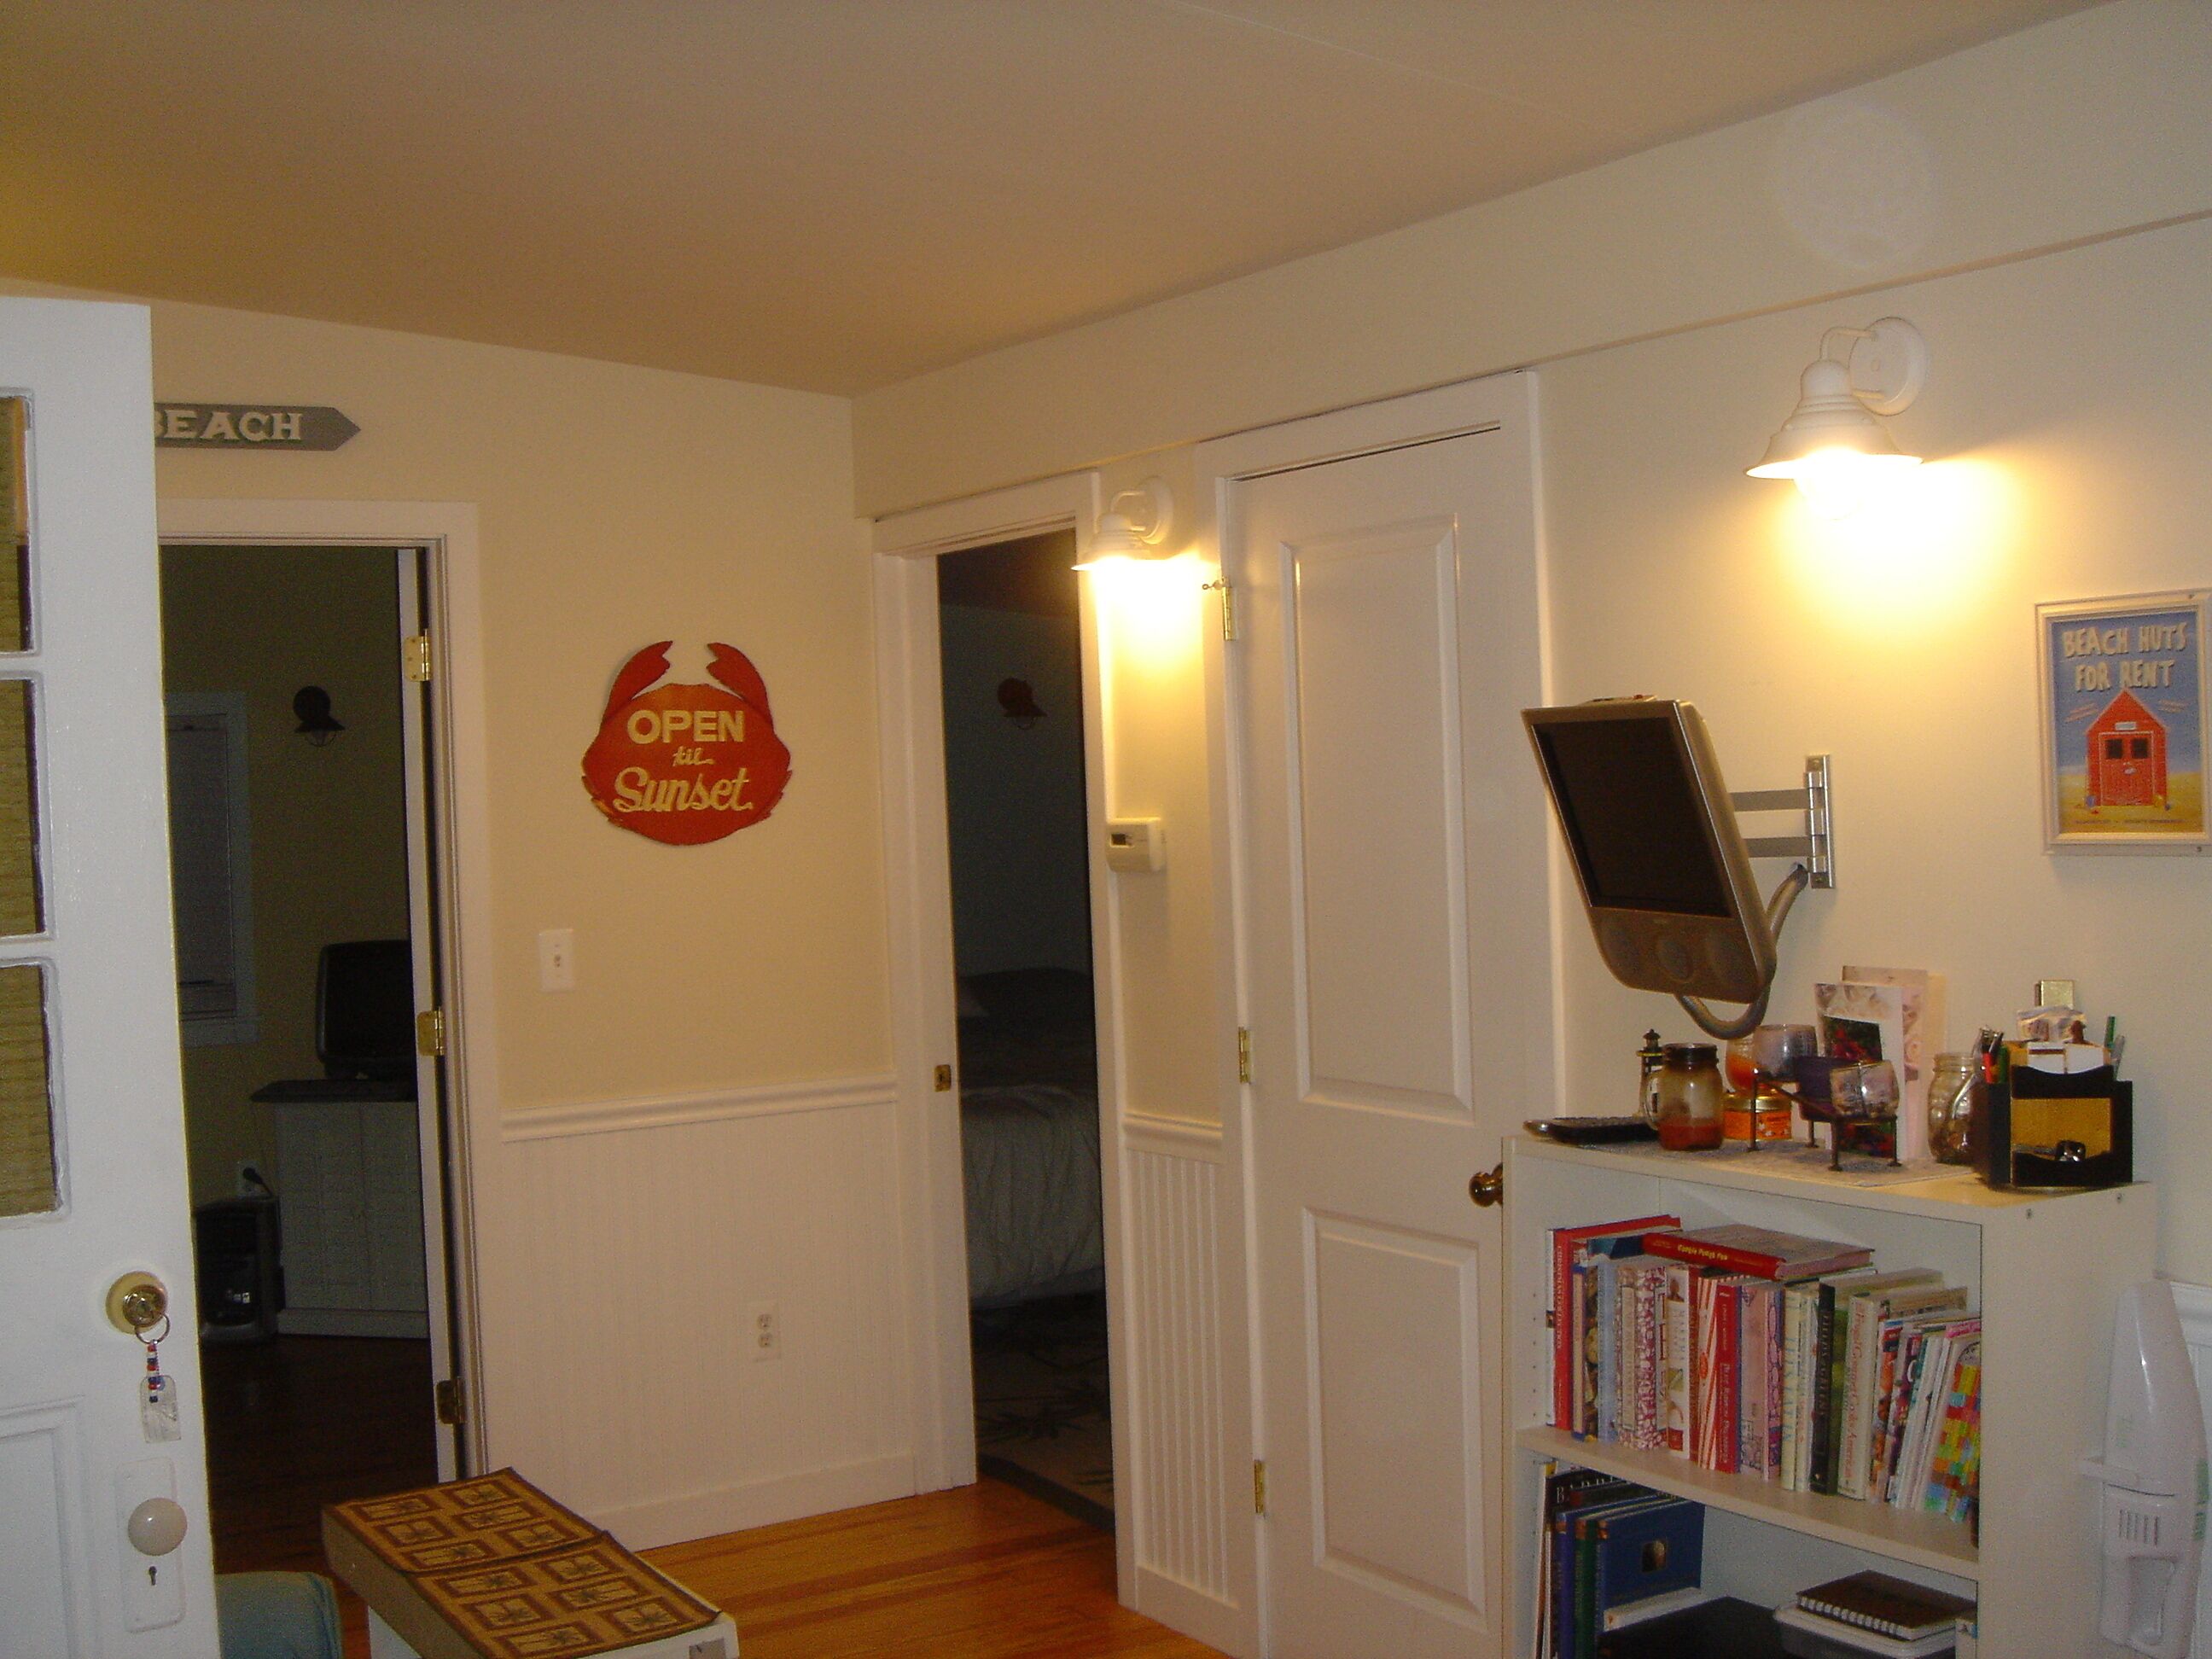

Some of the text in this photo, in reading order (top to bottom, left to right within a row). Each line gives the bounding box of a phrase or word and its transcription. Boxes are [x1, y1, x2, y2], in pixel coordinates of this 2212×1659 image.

[2062, 621, 2188, 658] BEACH HUTS
[2075, 659, 2175, 692] FOR RENT
[627, 709, 745, 744] OPEN
[613, 766, 754, 812] Sunset
